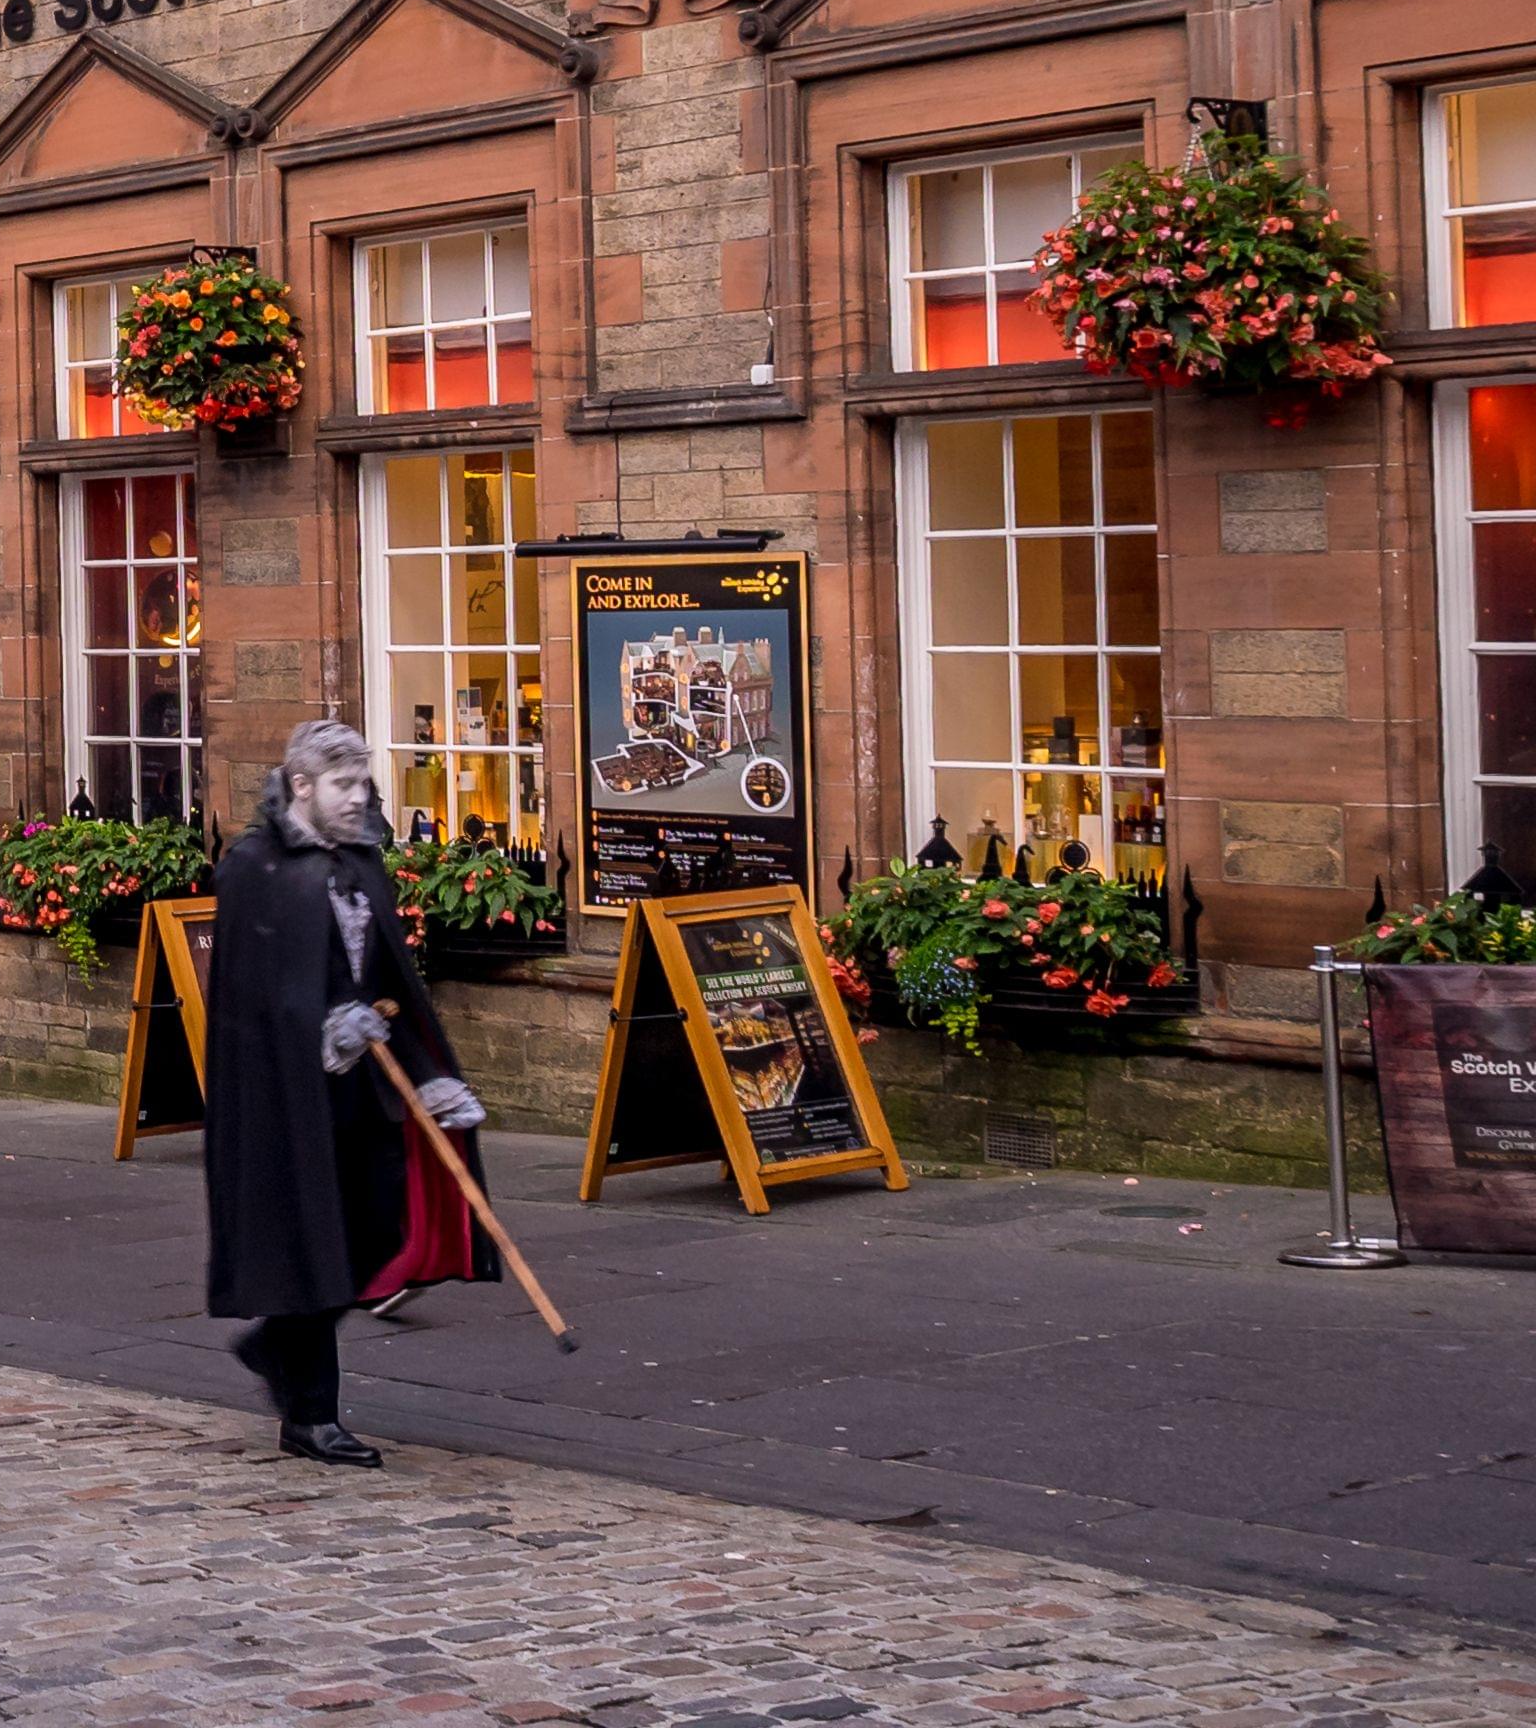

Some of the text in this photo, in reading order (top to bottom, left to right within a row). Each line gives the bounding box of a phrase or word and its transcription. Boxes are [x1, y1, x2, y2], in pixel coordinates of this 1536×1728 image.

[586, 575, 652, 592] COME IN
[587, 595, 621, 609] AND
[706, 969, 795, 989] SEE THE WORLD'S LARGEST
[702, 980, 807, 1002] COLLECTION OF SCOTCH WHISKY
[1462, 1053, 1484, 1062] The
[1450, 1060, 1522, 1075] Scotch
